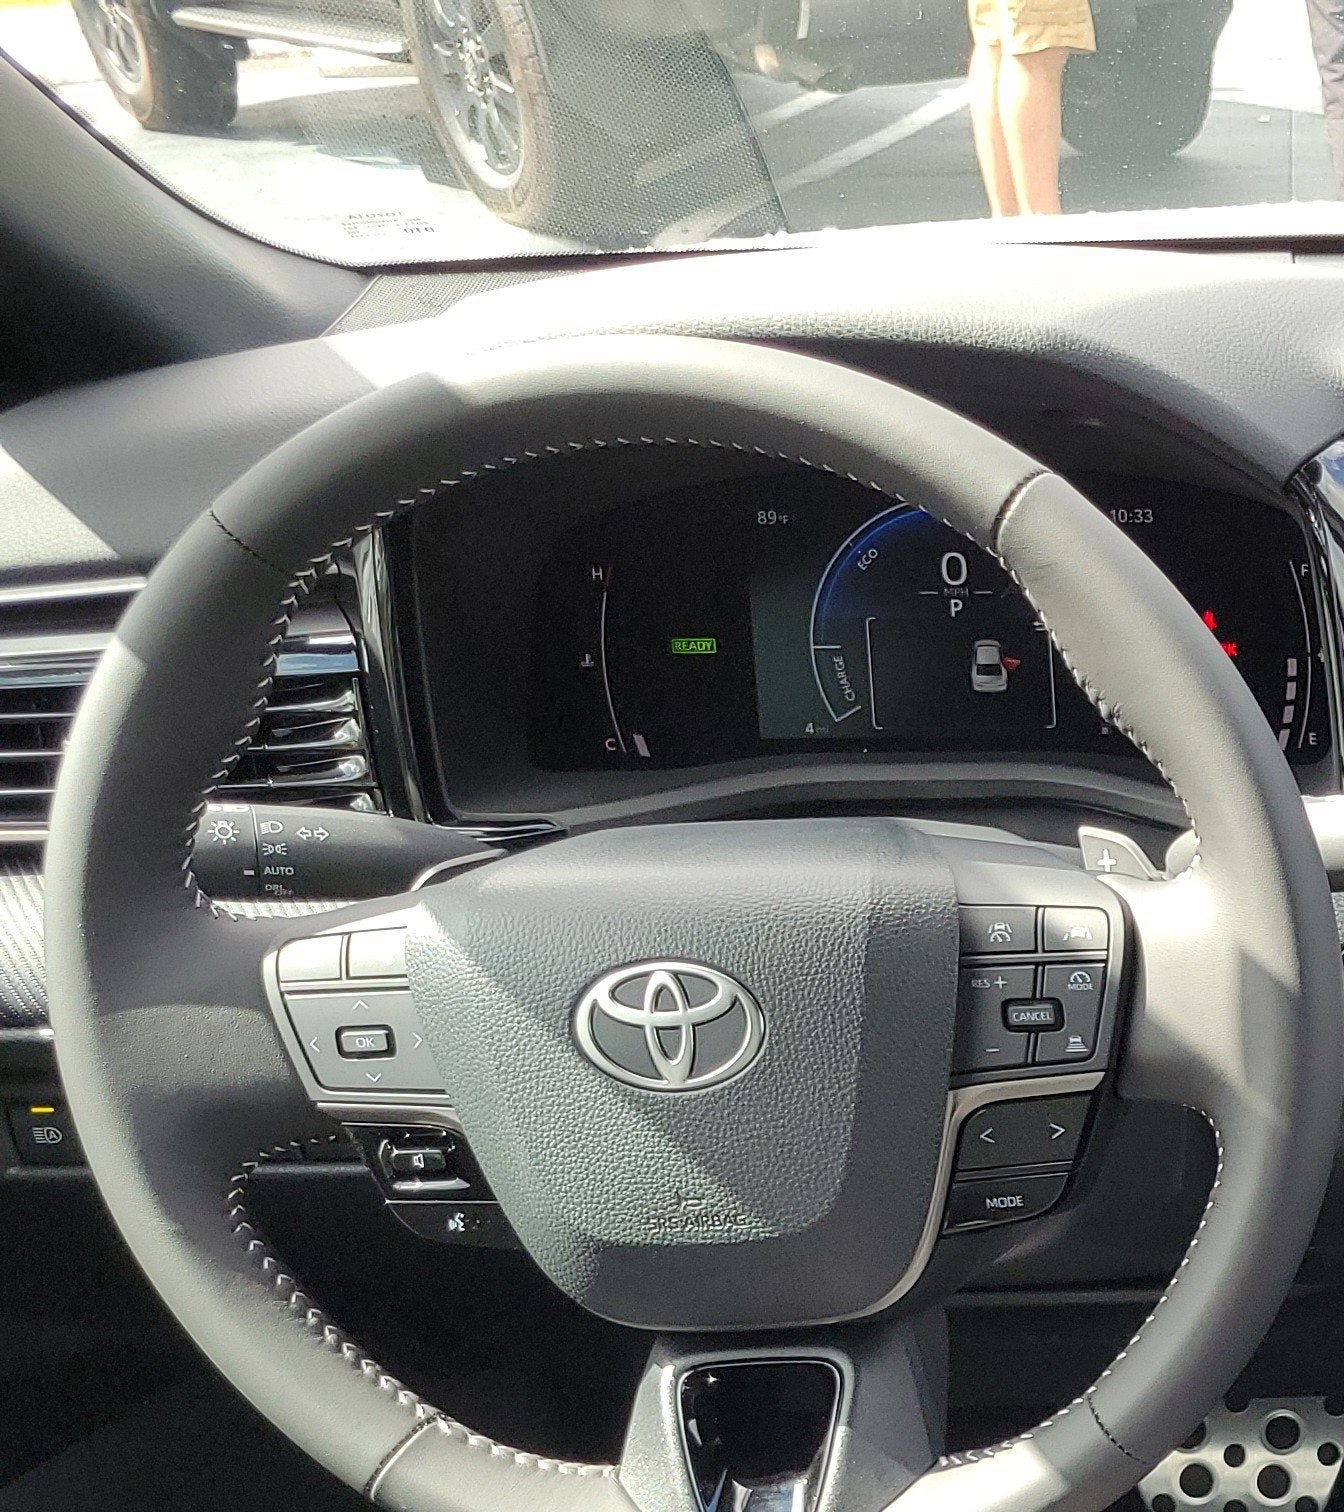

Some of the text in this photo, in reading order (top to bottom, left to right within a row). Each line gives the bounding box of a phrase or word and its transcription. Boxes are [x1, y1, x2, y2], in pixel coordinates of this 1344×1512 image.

[1109, 509, 1154, 523] 10:33
[857, 548, 878, 571] ECO
[592, 567, 603, 581] H
[943, 587, 969, 597] MPH
[950, 600, 963, 617] P
[673, 640, 713, 652] READY
[833, 655, 856, 702] CHARGE
[1308, 732, 1317, 745] E
[264, 866, 294, 876] AUTO
[1067, 983, 1094, 991] MODE
[1012, 1011, 1052, 1021] CANCEL
[355, 1037, 375, 1048] OK
[985, 1195, 1024, 1209] MODE
